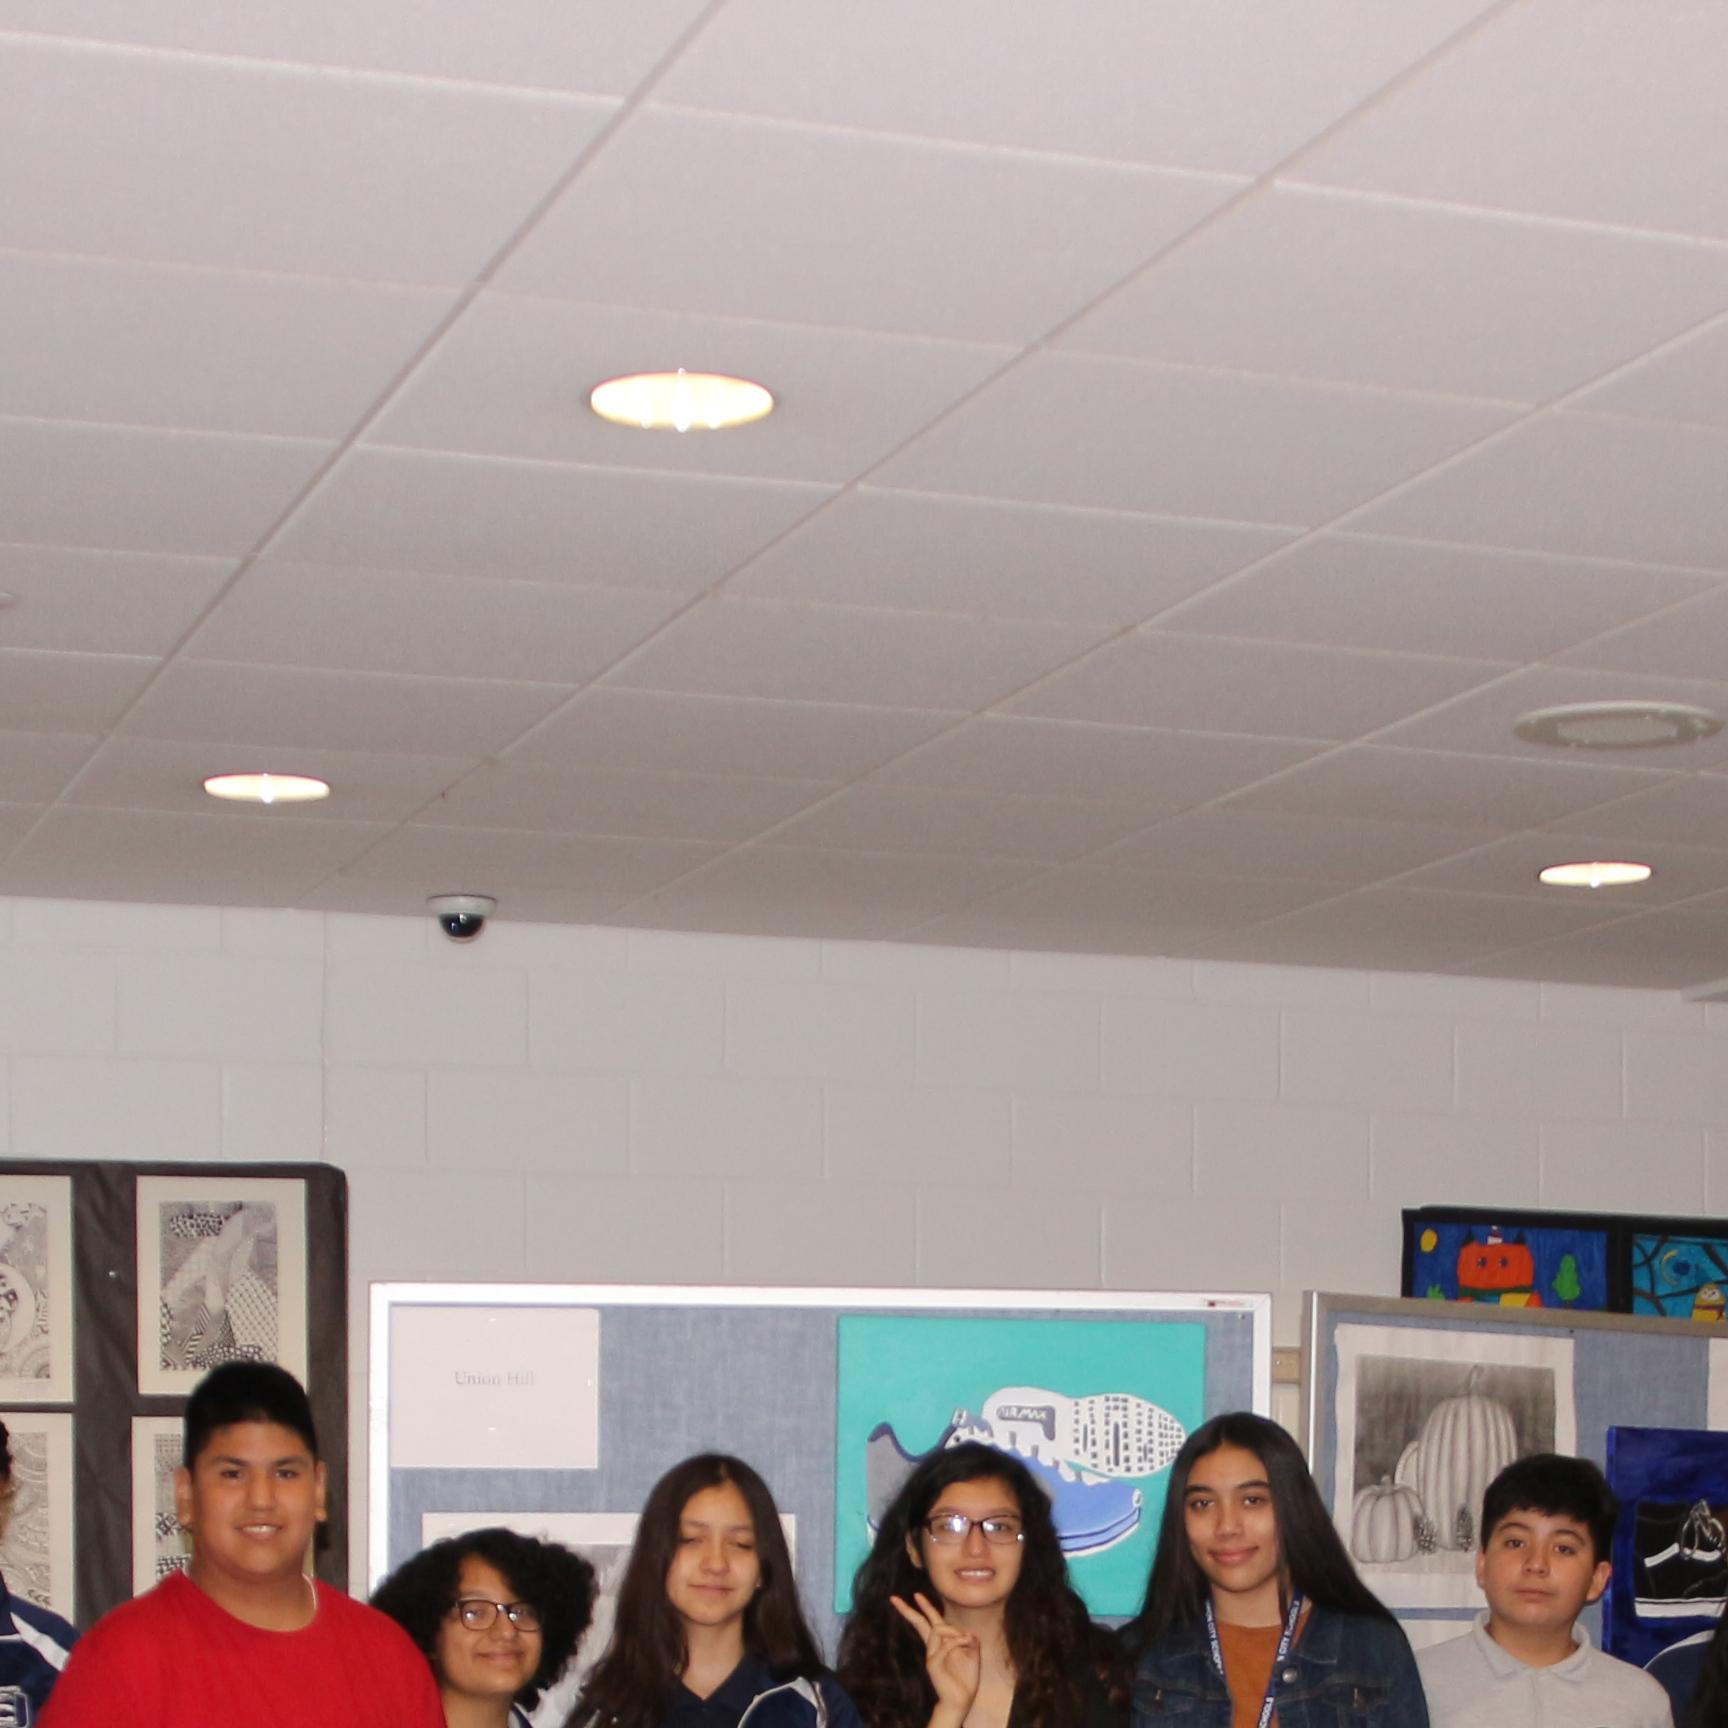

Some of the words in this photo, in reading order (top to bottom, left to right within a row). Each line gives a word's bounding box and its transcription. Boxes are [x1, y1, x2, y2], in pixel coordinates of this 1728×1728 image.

[455, 1370, 501, 1385] Union
[507, 1370, 534, 1385] Hill
[997, 1405, 1017, 1418] AIR
[1017, 1406, 1047, 1420] MAX
